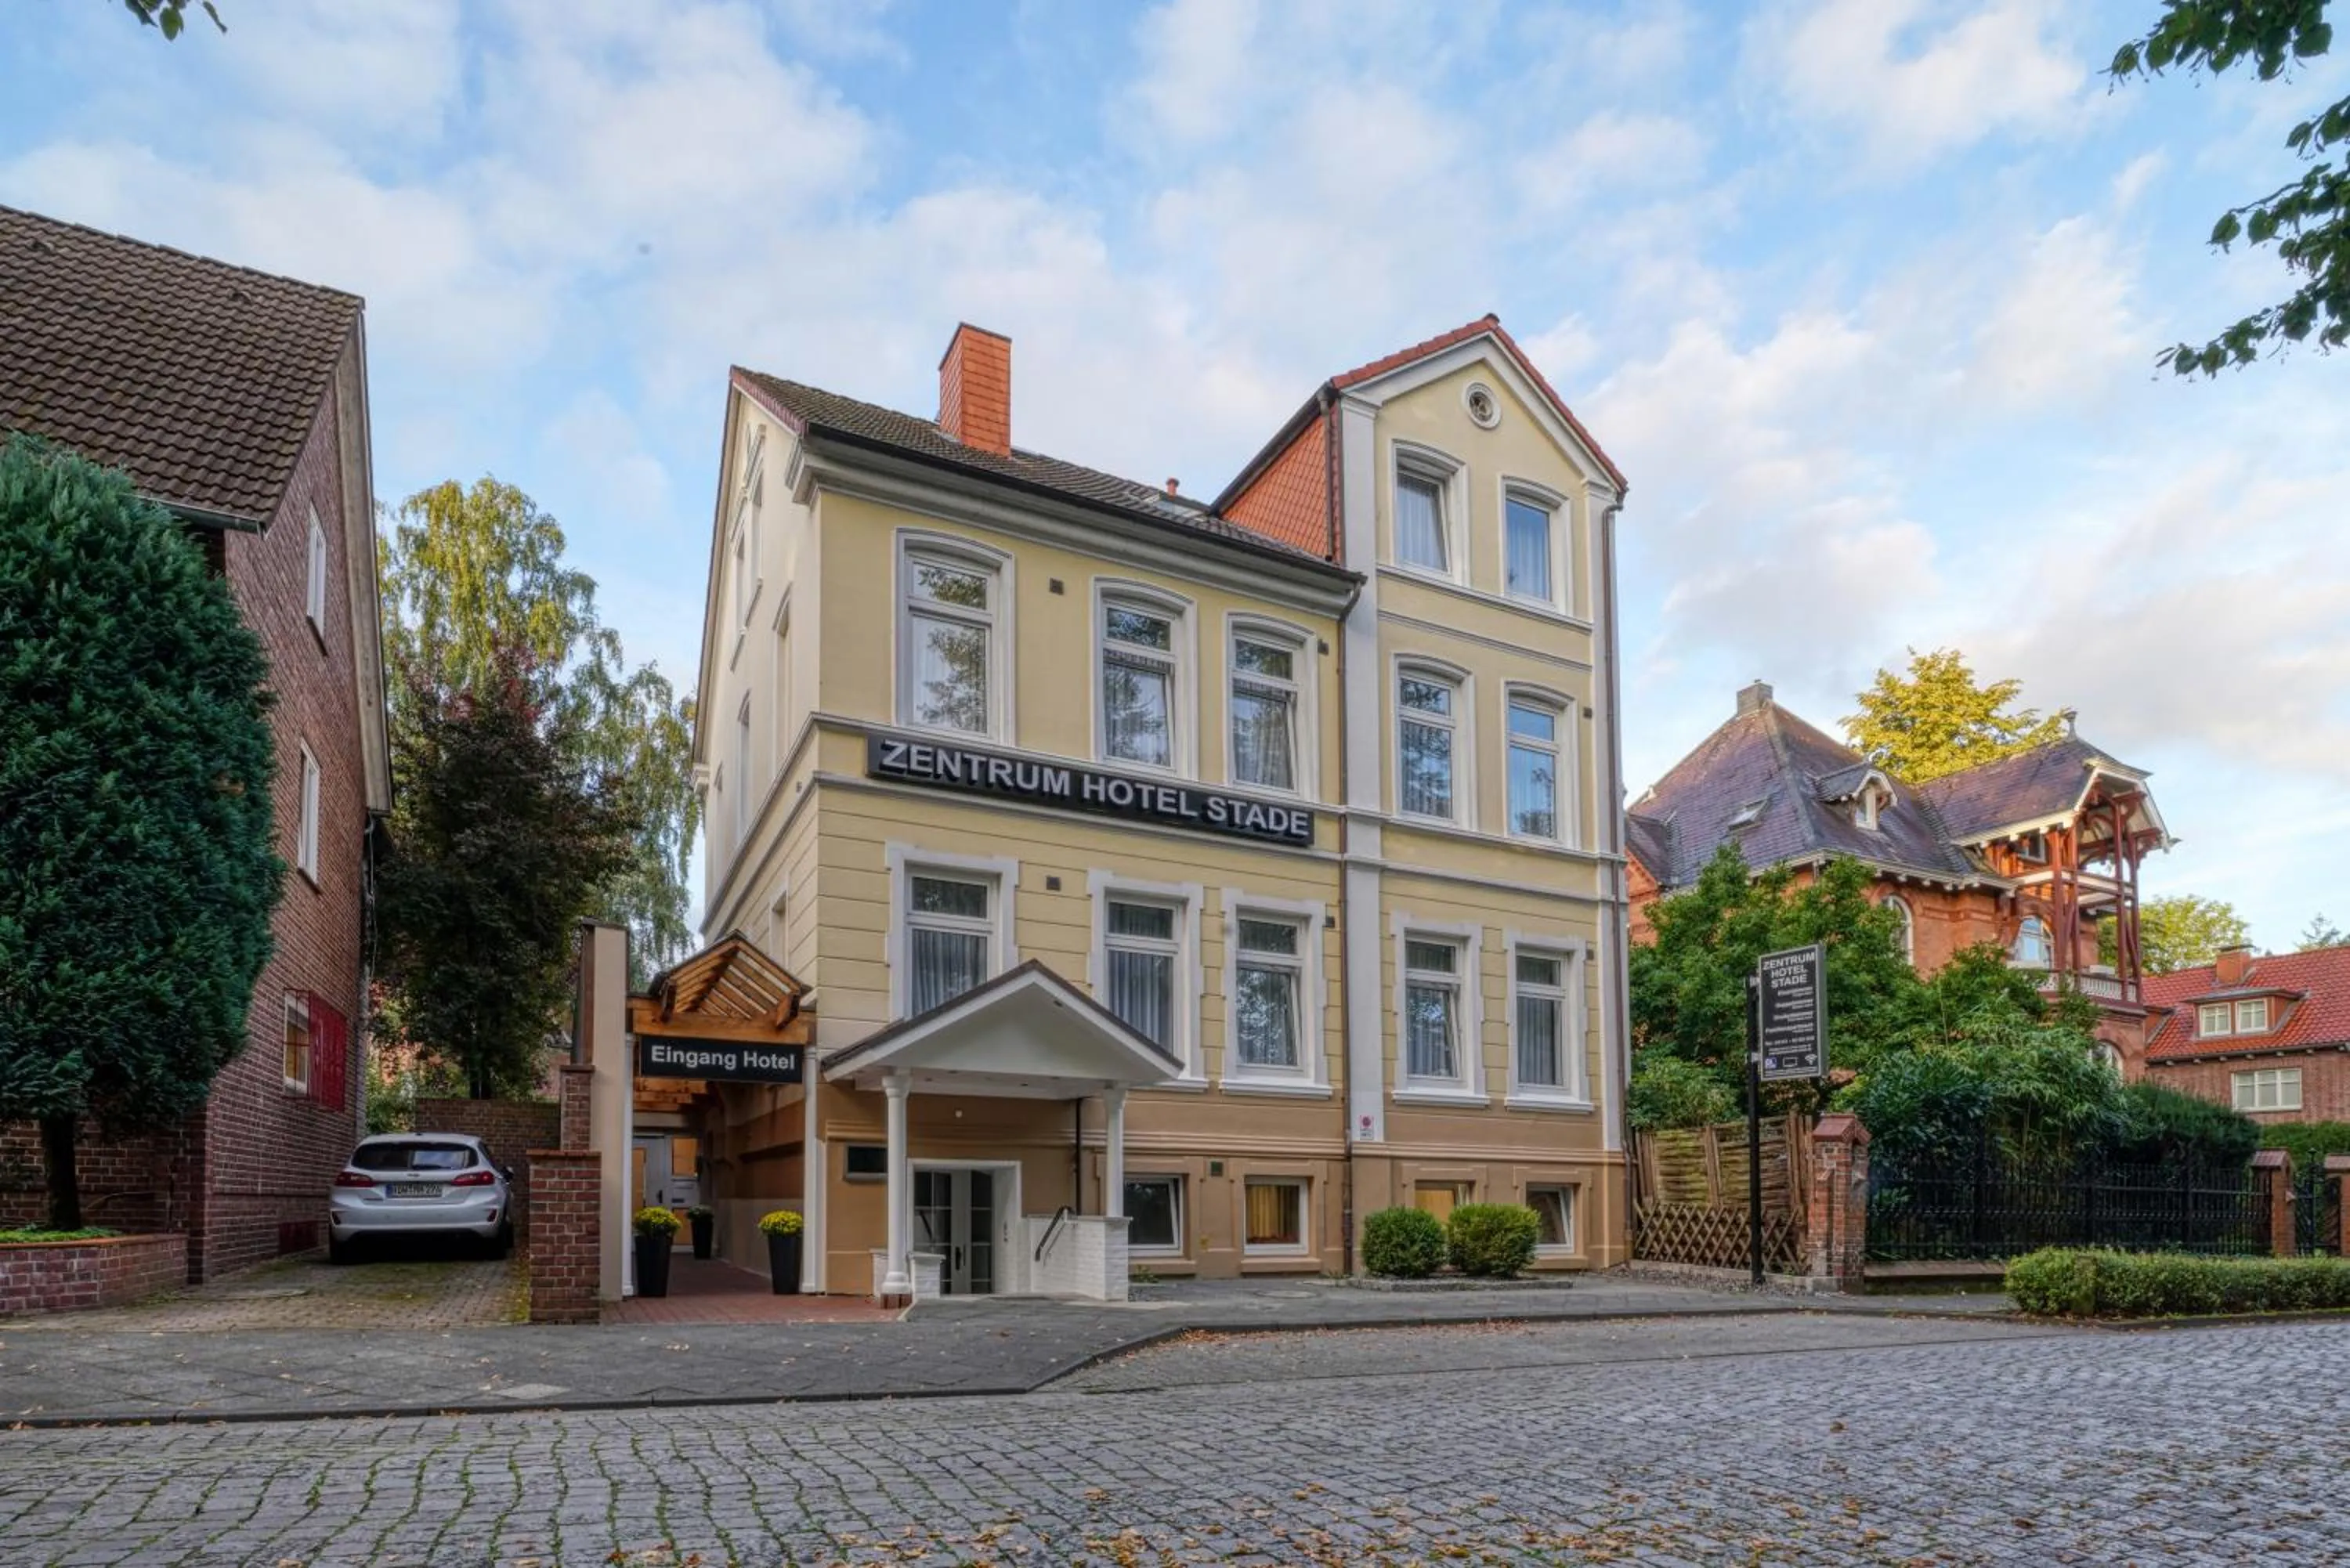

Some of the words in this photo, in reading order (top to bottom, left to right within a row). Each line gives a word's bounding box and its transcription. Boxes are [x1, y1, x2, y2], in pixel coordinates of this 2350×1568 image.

[880, 739, 1070, 796] ZENTRUM
[1083, 776, 1198, 818] HOTEL
[1206, 796, 1309, 836] STADE
[1762, 952, 1815, 970] ZENTRUM
[1771, 964, 1808, 978] HOTEL
[1771, 974, 1807, 989] STADE
[651, 1045, 736, 1070] Eingang
[743, 1050, 795, 1070] Hotel
